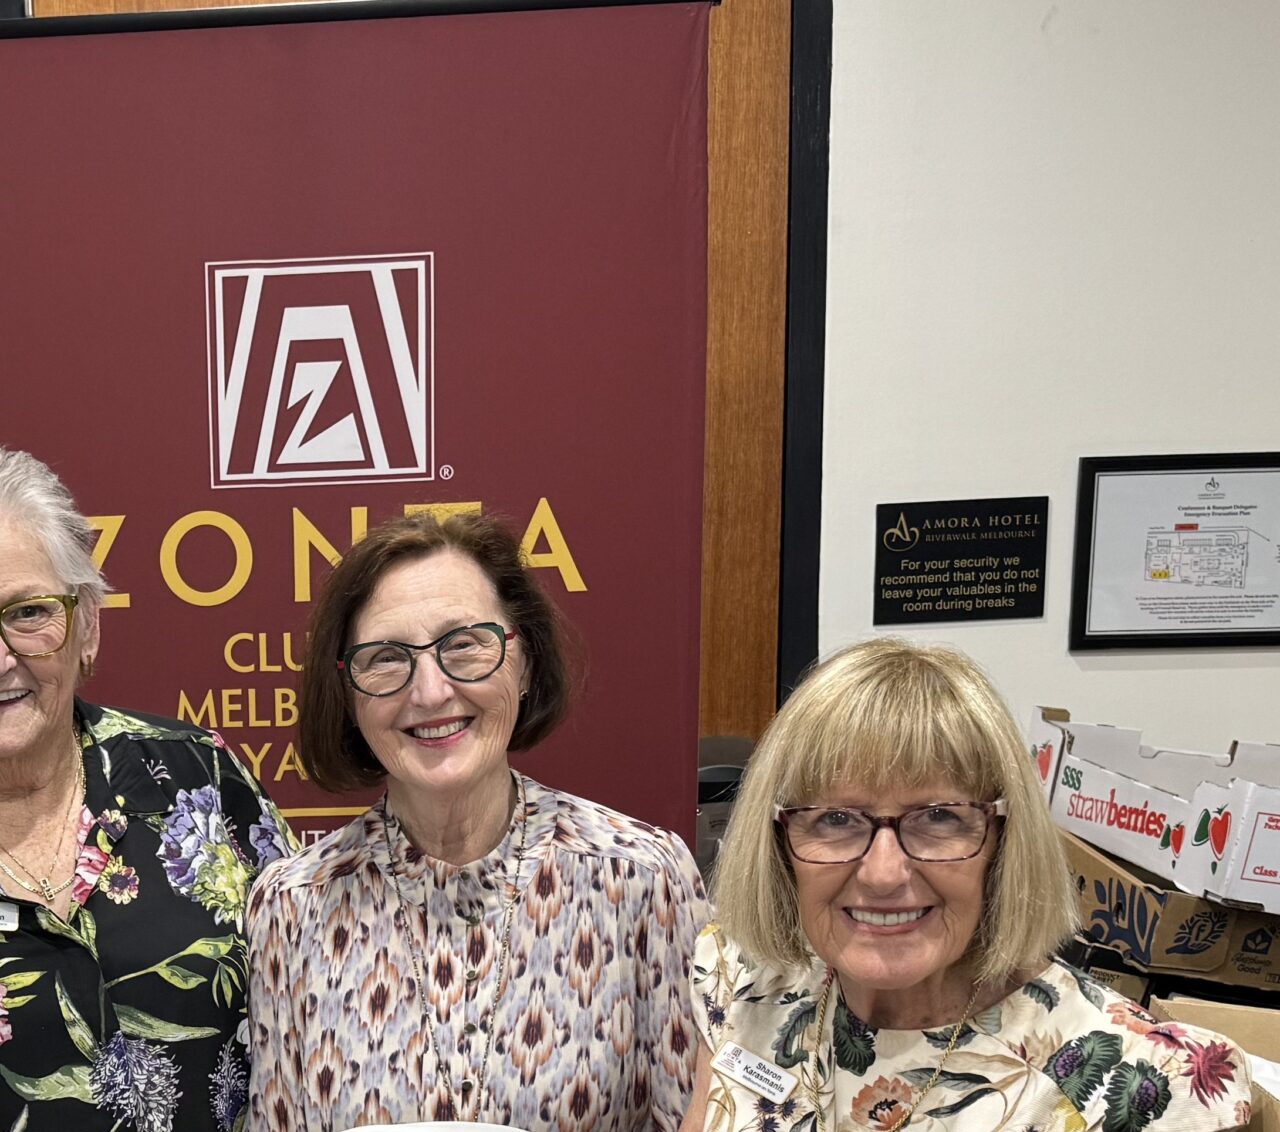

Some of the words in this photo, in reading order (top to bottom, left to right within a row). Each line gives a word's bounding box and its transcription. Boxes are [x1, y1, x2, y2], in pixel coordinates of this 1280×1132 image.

[922, 517, 981, 530] AMORA
[989, 514, 1040, 527] HOTEL
[925, 532, 977, 542] RIVERWALK
[980, 530, 1036, 540] MELBOURNE
[901, 559, 920, 570] For
[924, 560, 950, 572] your
[953, 556, 999, 568] security
[1003, 556, 1020, 566] we
[880, 572, 950, 585] recommend
[953, 571, 976, 582] that
[979, 572, 1000, 583] you
[1003, 569, 1018, 580] do
[1021, 568, 1040, 579] not
[882, 588, 913, 599] leave
[916, 587, 943, 600] your
[946, 584, 1001, 596] valuables
[1004, 583, 1015, 593] in
[1018, 582, 1037, 593] the
[903, 601, 933, 612] room
[935, 599, 973, 612] during
[975, 597, 1015, 609] breaks
[1067, 788, 1167, 838] strawberries
[1253, 866, 1278, 877] Class
[756, 1062, 782, 1081] Sharon
